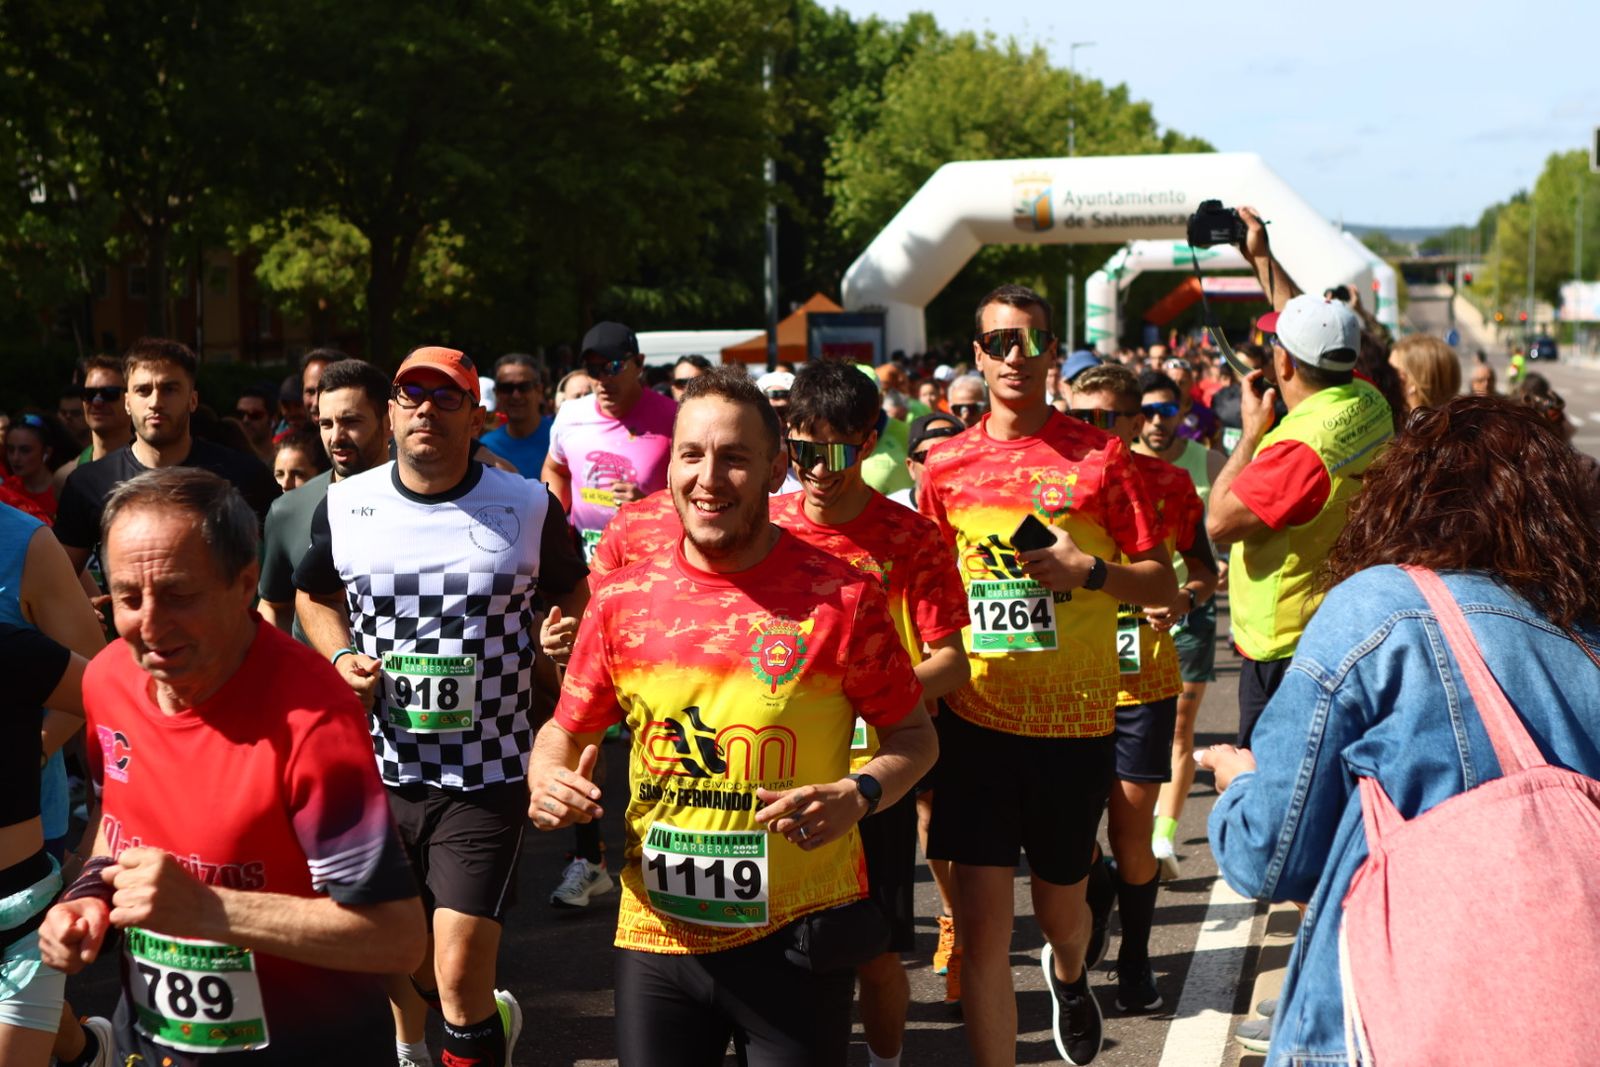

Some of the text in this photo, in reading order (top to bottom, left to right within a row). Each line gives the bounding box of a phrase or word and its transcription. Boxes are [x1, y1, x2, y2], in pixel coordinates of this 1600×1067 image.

[1063, 189, 1186, 210] Ayuntamiento
[1064, 213, 1187, 228] de Salamanca
[988, 588, 1027, 598] CARRERA
[974, 598, 1051, 632] 1264
[405, 665, 448, 673] CARRERA
[395, 675, 460, 710] 918
[677, 789, 753, 811] FERNANDO
[647, 828, 761, 849] XIV SAN FERNANDO
[674, 842, 730, 854] CARRERA
[648, 853, 761, 900] 1119
[148, 947, 209, 969] CARRERA
[137, 962, 234, 1020] 789
